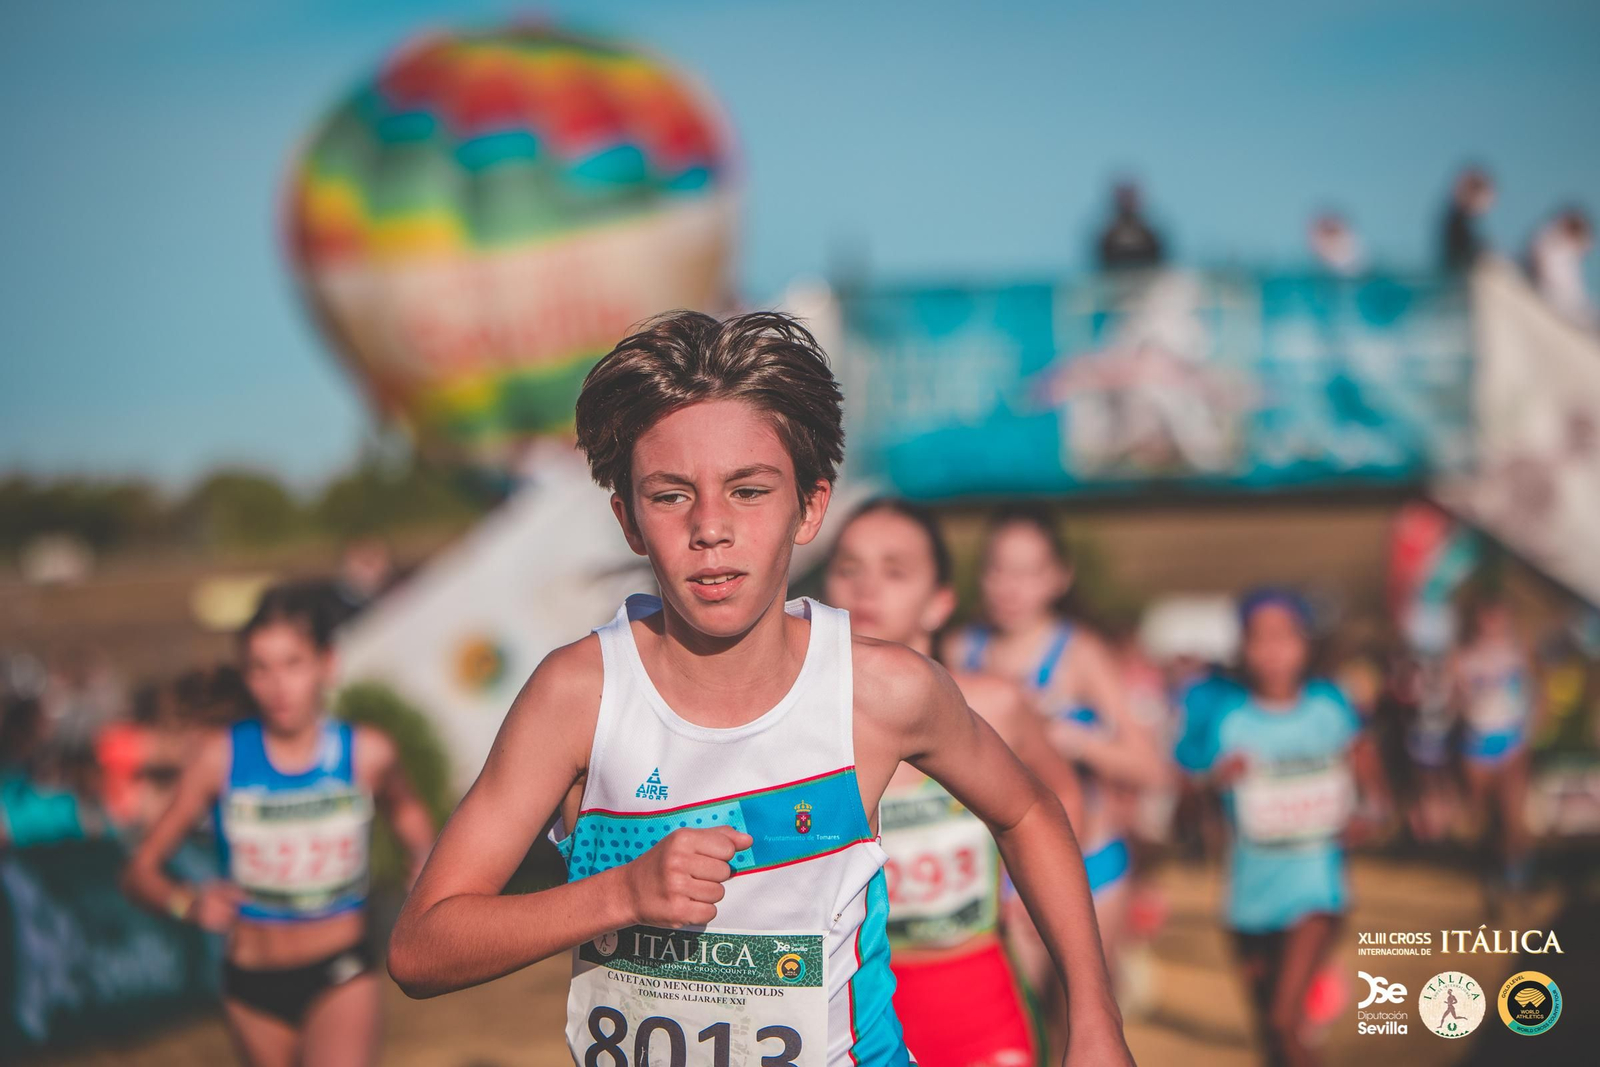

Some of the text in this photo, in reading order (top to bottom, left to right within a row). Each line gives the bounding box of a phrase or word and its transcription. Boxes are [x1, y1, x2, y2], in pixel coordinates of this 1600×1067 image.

[637, 783, 668, 795] AIRE
[633, 932, 757, 968] ITÁLICA
[633, 958, 692, 971] INTERNATIONAL
[721, 967, 757, 976] COUNTRY
[607, 971, 784, 998] CAYETANO MENCHON REYNOLDS
[638, 988, 746, 1006] TOMARES ALJARAFE XXI
[584, 1005, 803, 1067] 8013
